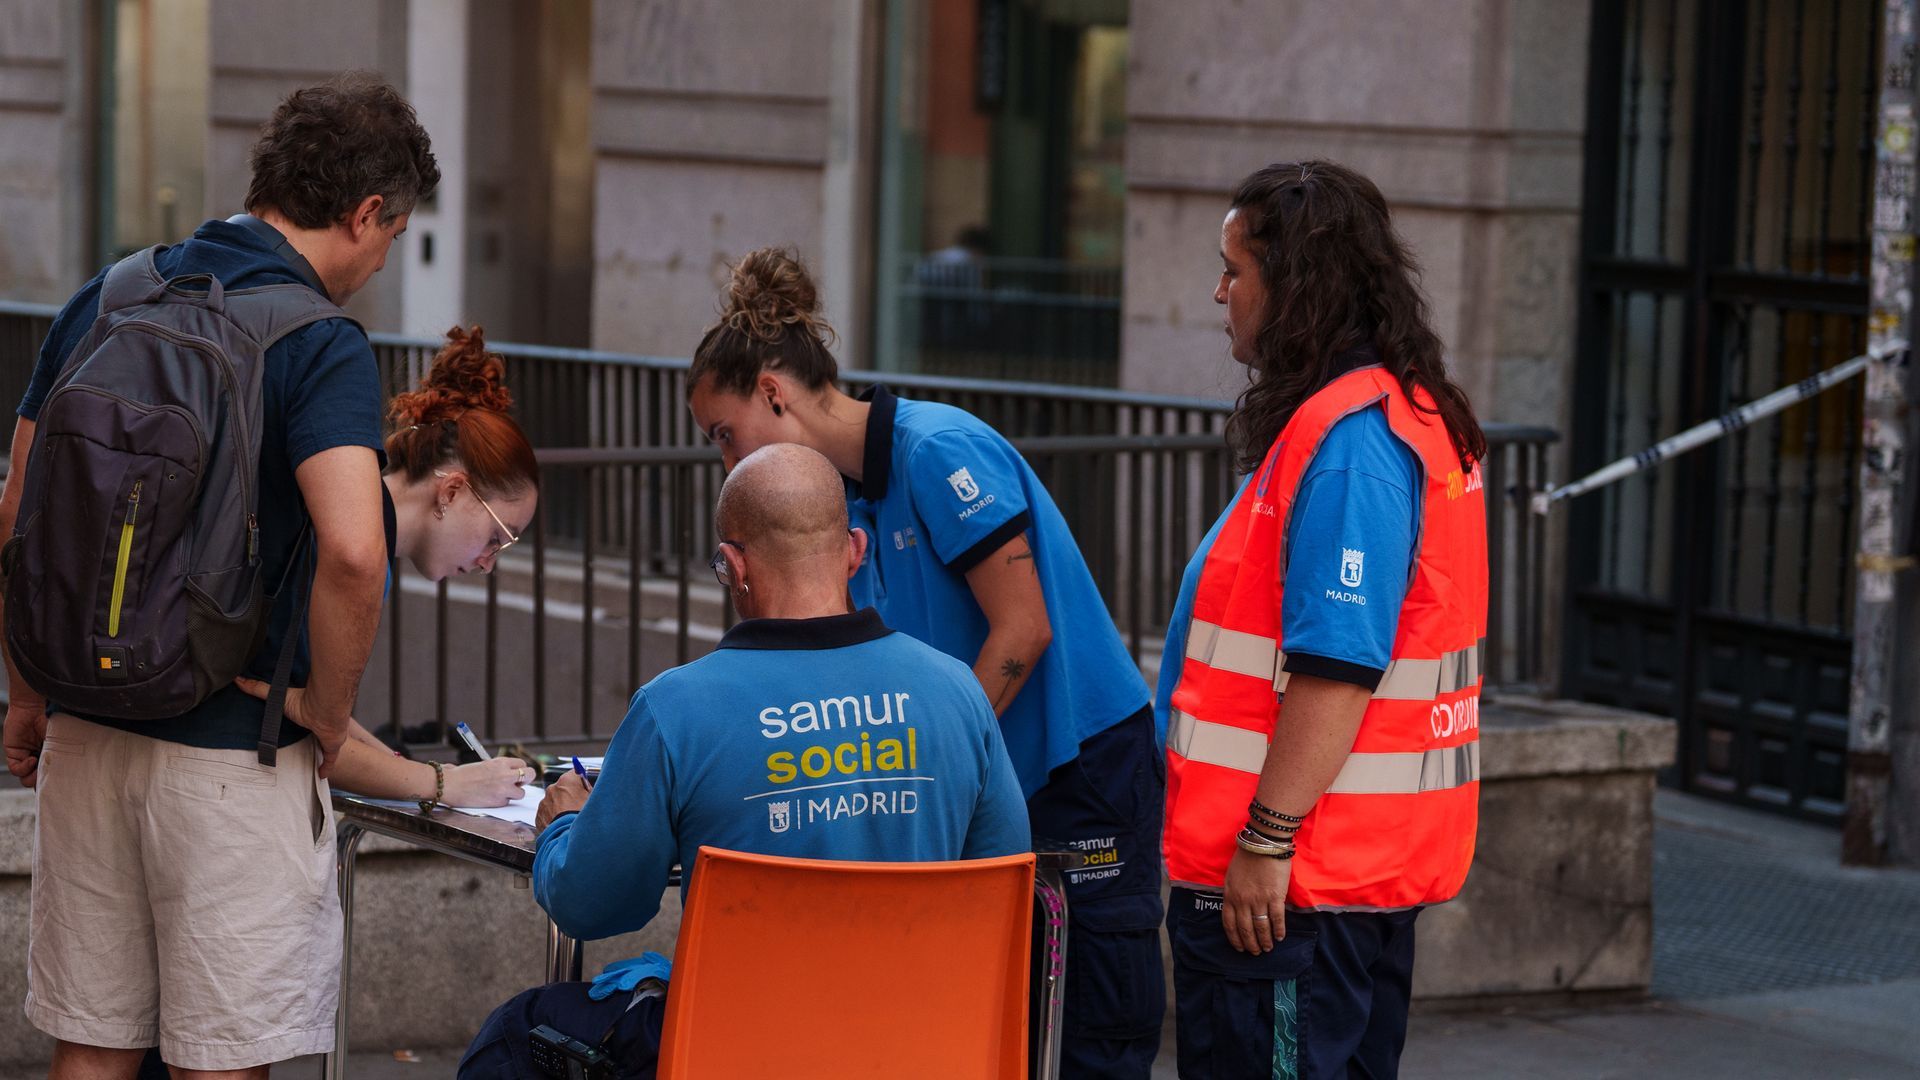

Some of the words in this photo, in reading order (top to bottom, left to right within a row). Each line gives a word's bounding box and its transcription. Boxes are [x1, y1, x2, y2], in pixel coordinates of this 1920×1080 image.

[959, 494, 995, 521] MADRID
[1325, 589, 1367, 606] MADRID
[759, 692, 910, 739] samur
[766, 727, 917, 784] social
[808, 790, 918, 823] MADRID
[1082, 848, 1118, 866] ocial
[1082, 868, 1121, 881] MADRID
